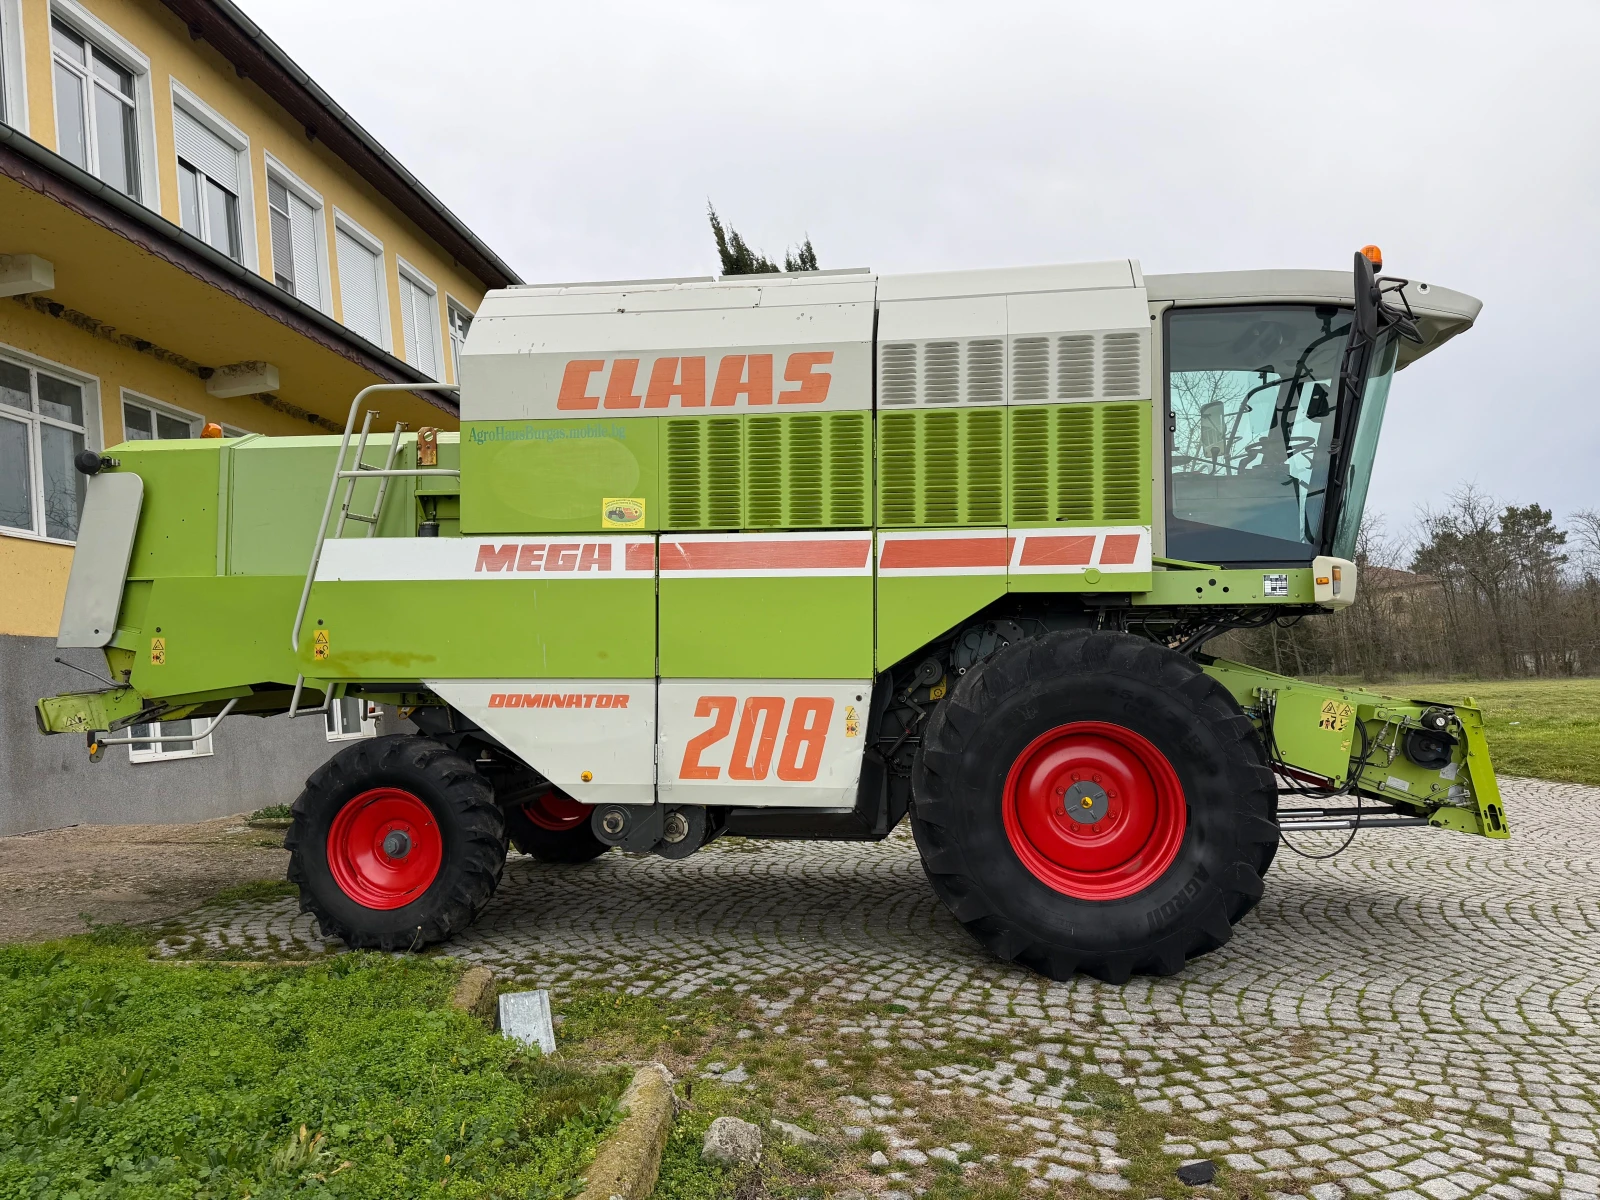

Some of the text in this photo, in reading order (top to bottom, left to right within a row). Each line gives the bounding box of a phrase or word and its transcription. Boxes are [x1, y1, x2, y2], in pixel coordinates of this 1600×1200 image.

[557, 352, 834, 410] CLAAS
[469, 423, 626, 445] AgroHausBurgas.mobile.bg
[476, 544, 612, 572] MEGA
[488, 694, 630, 709] DOMINATOR
[679, 696, 835, 782] 208
